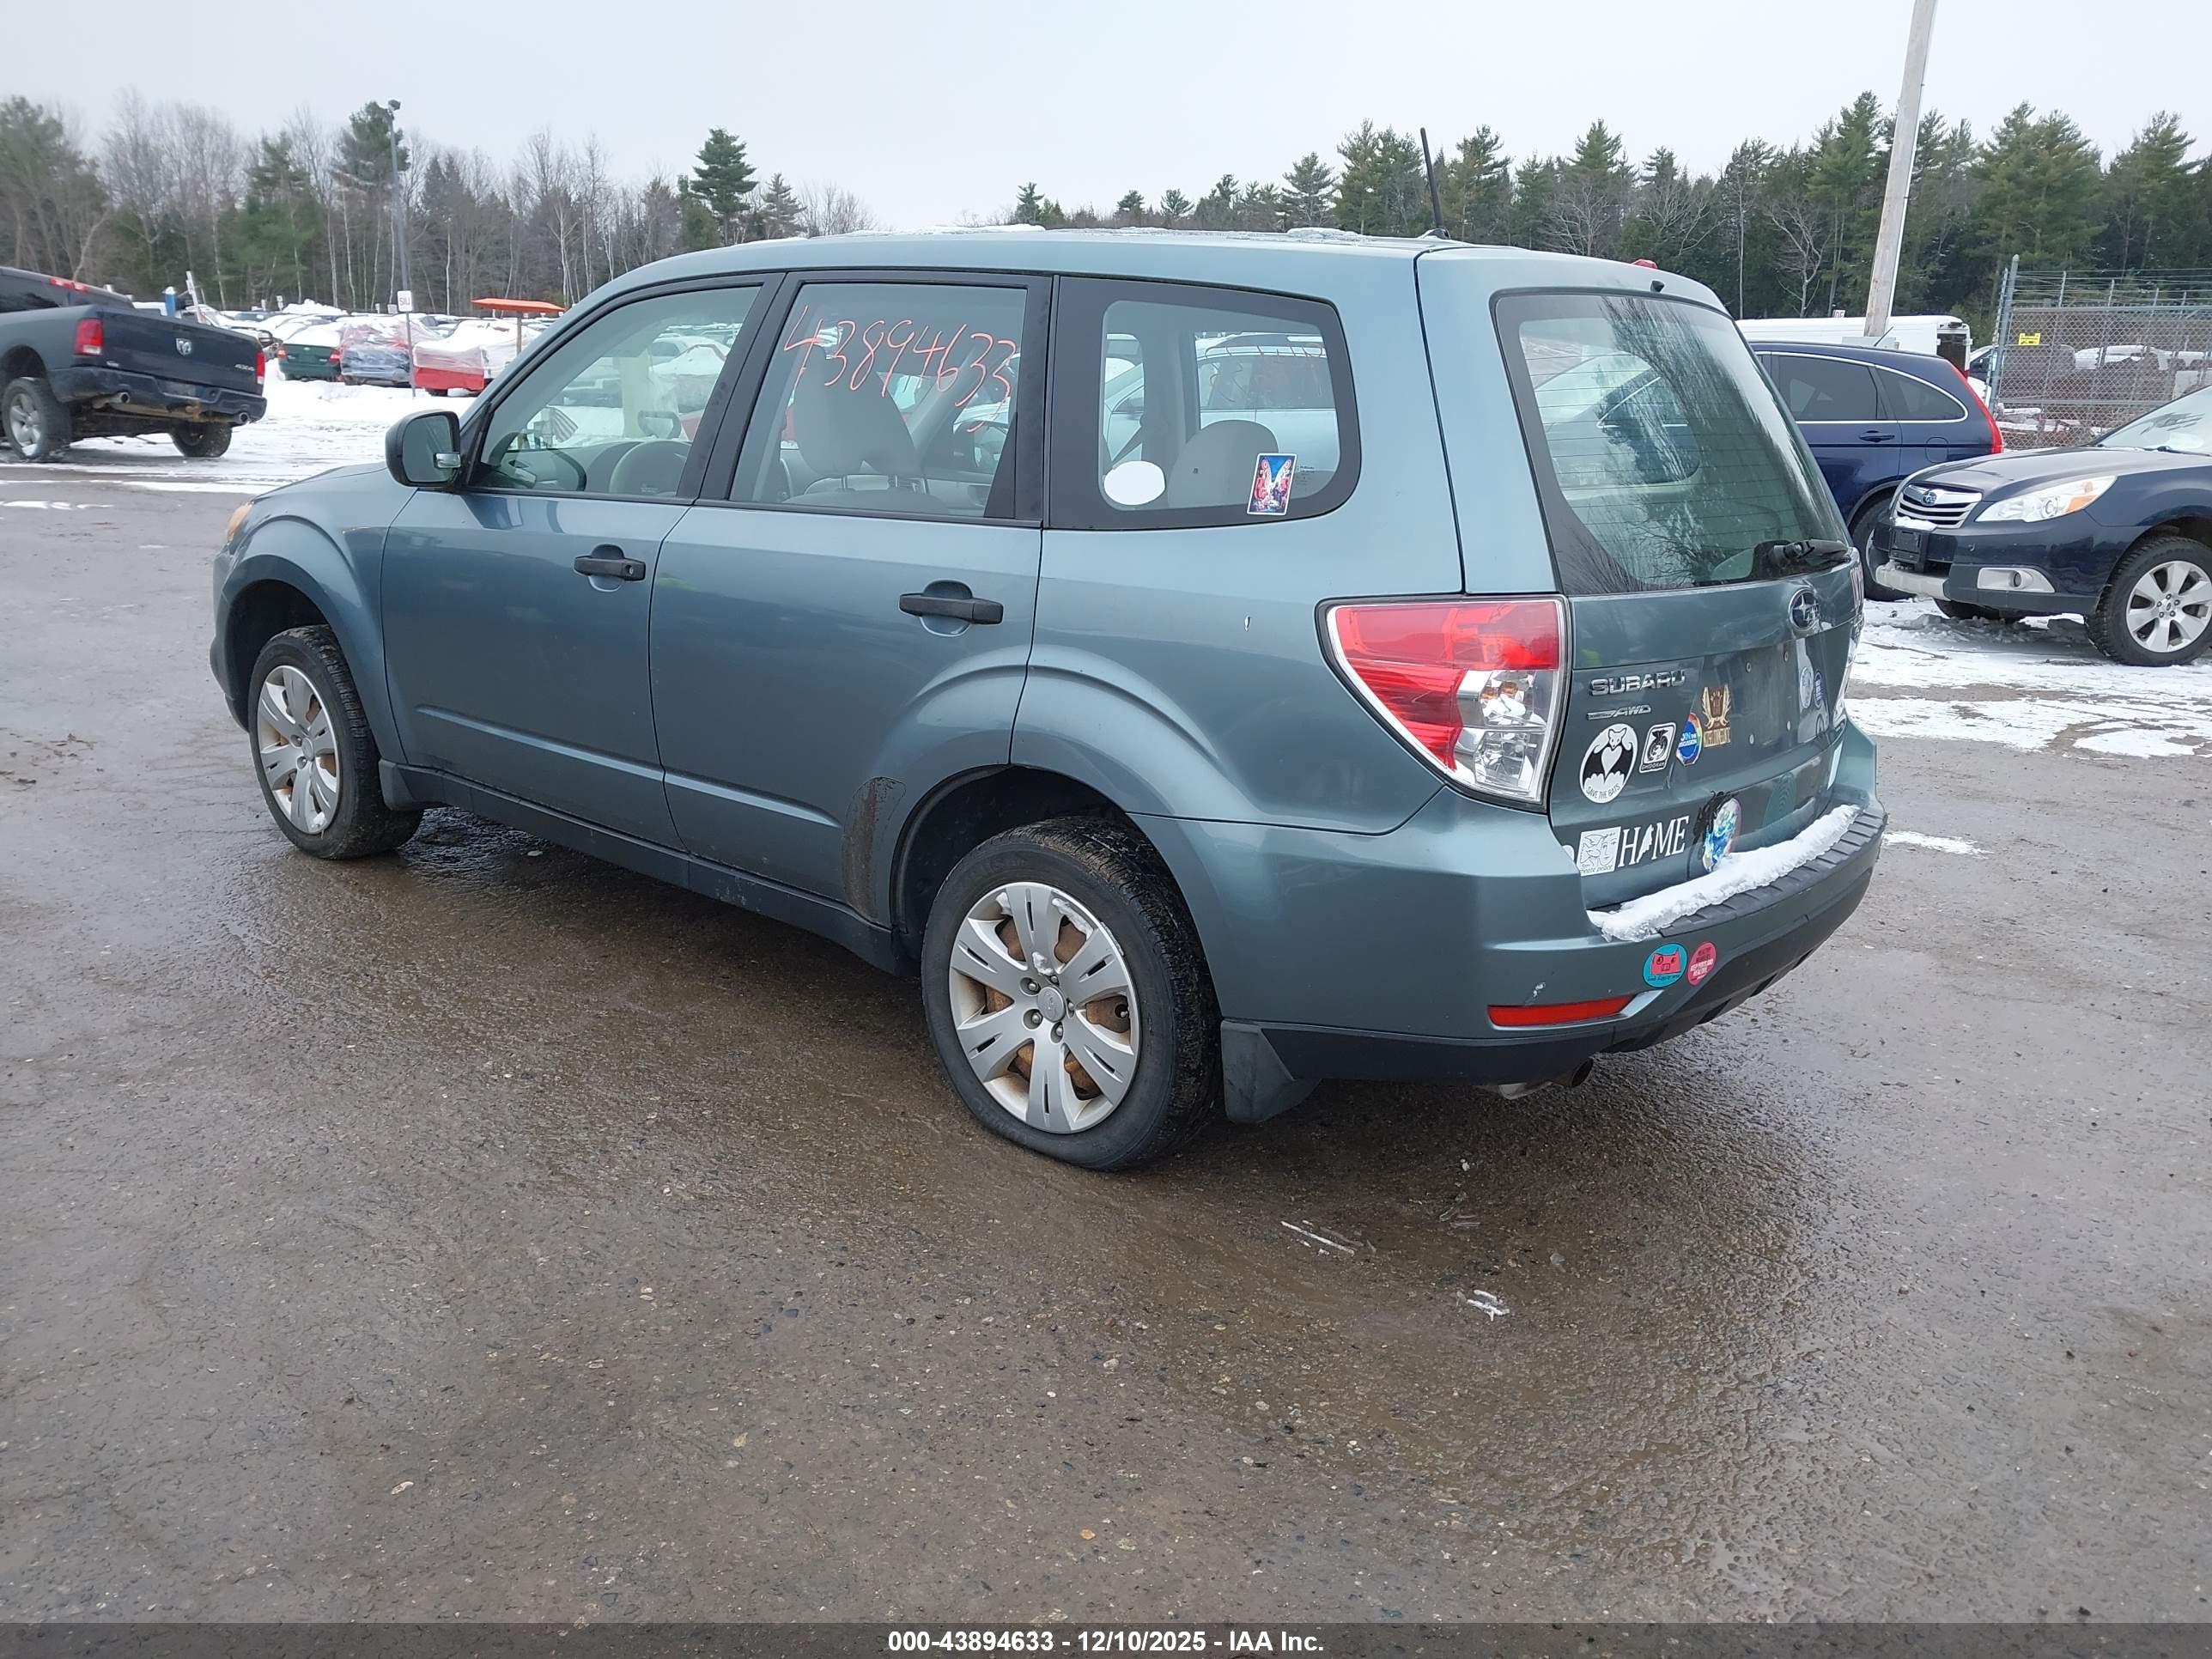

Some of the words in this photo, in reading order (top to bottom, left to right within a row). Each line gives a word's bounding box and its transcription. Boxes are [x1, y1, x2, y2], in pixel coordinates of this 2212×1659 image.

[783, 305, 1017, 432] 43894633
[1589, 670, 1686, 696] SUBARU
[1613, 704, 1652, 718] AWD
[1585, 786, 1598, 799] SAVE
[1598, 790, 1608, 799] THE
[1607, 782, 1621, 797] BATS
